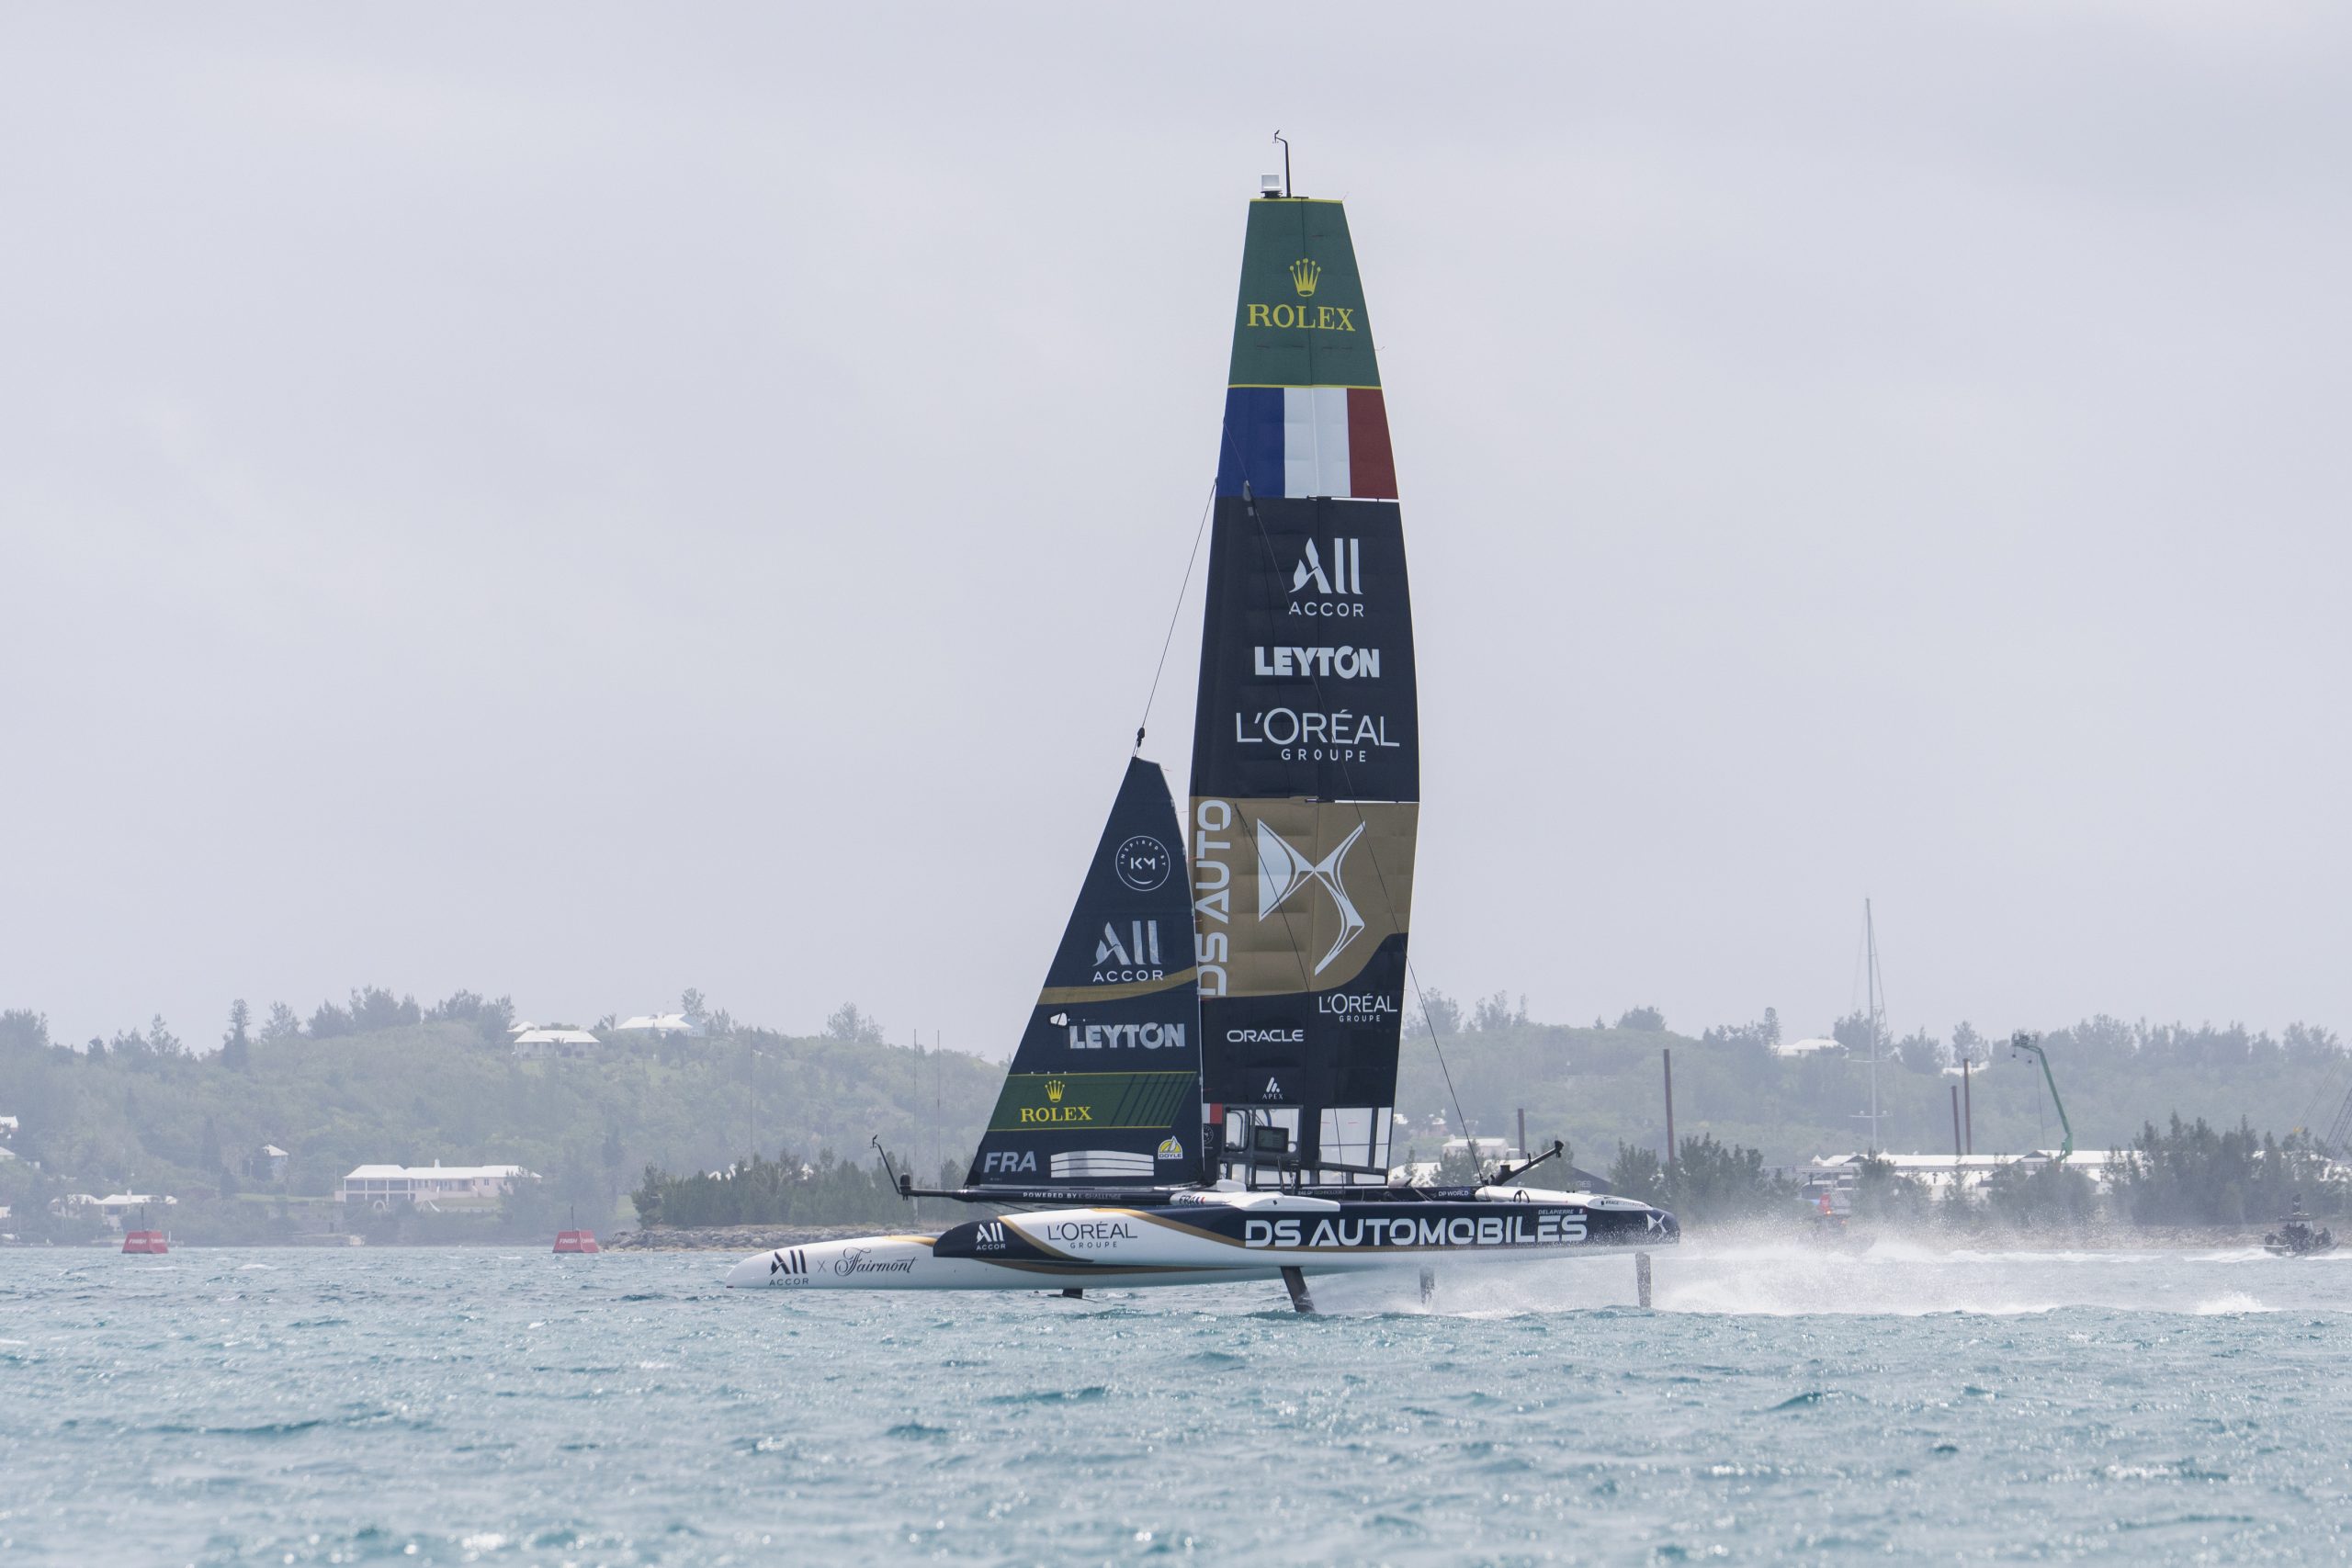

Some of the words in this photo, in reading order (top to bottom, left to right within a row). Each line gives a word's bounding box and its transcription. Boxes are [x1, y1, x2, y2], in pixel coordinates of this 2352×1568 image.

[1247, 304, 1355, 332] ROLEX
[1289, 602, 1364, 617] ACCOR
[1254, 645, 1380, 679] LEYTON
[1236, 707, 1400, 748] L'ORÉAL
[1281, 749, 1366, 762] GROUPE
[1120, 840, 1159, 864] INSPIRED
[1194, 799, 1231, 924] AUTO
[1130, 857, 1156, 870] KM
[1196, 931, 1228, 997] DS
[1092, 969, 1164, 983] ACCOR
[1318, 993, 1398, 1014] L'ORÉAL
[1069, 1021, 1185, 1050] LEYTON
[1227, 1029, 1305, 1043] ORACLE
[1020, 1106, 1093, 1122] ROLEX
[983, 1150, 1037, 1174] FRA
[1047, 1220, 1138, 1241] L'ORÉAL
[1245, 1219, 1301, 1247] DS
[1309, 1213, 1588, 1247] AUTOMOBILES
[1069, 1241, 1118, 1249] GROUPE
[834, 1247, 919, 1277] Fairmont
[769, 1277, 809, 1287] ACCOR
